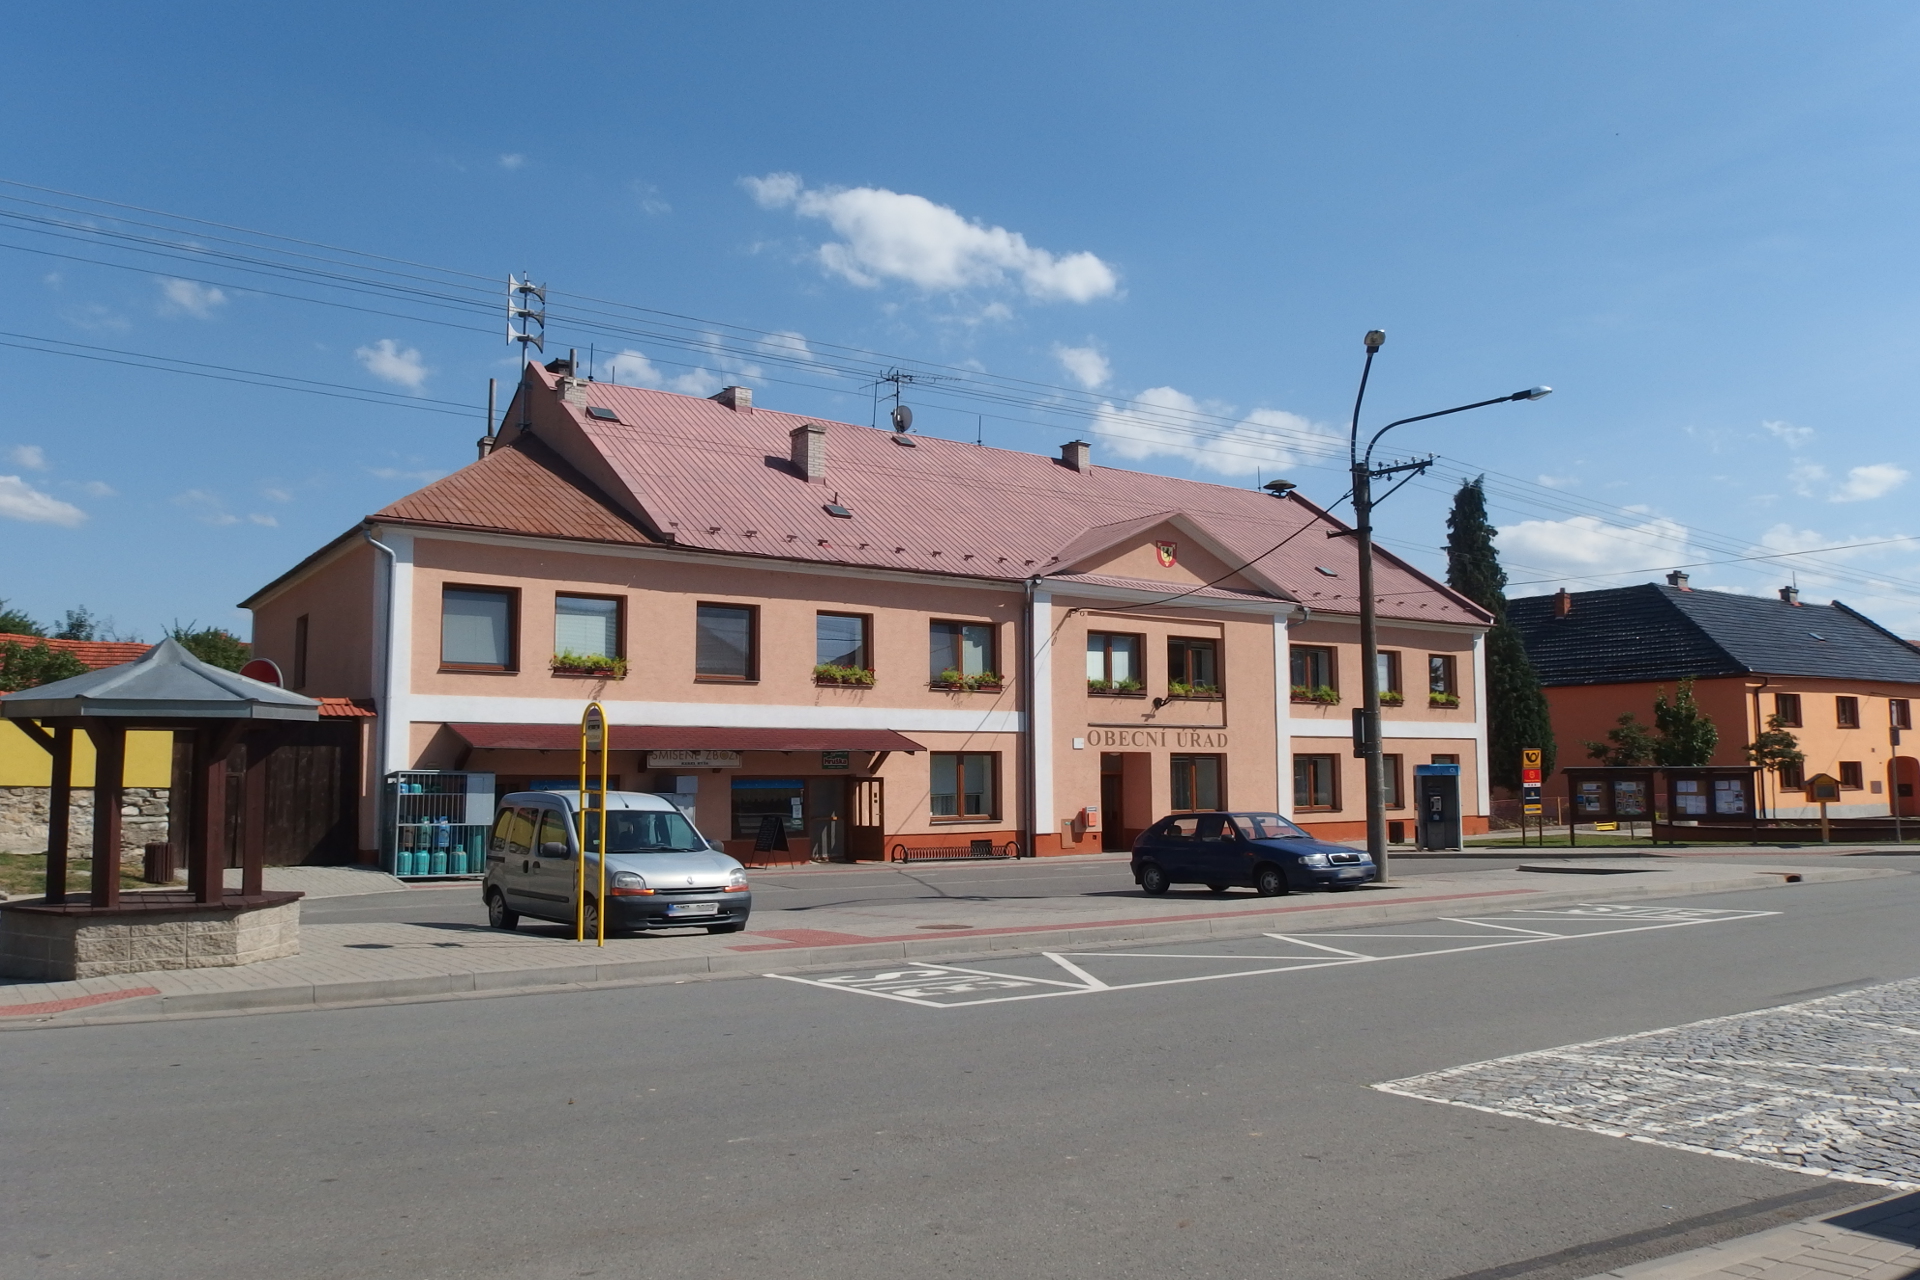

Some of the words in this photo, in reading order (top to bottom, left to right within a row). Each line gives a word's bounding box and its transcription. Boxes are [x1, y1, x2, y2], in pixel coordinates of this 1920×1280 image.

[1087, 728, 1167, 747] OBECNÍ
[1176, 728, 1229, 748] ÚŘAD
[817, 970, 1035, 997] BUS
